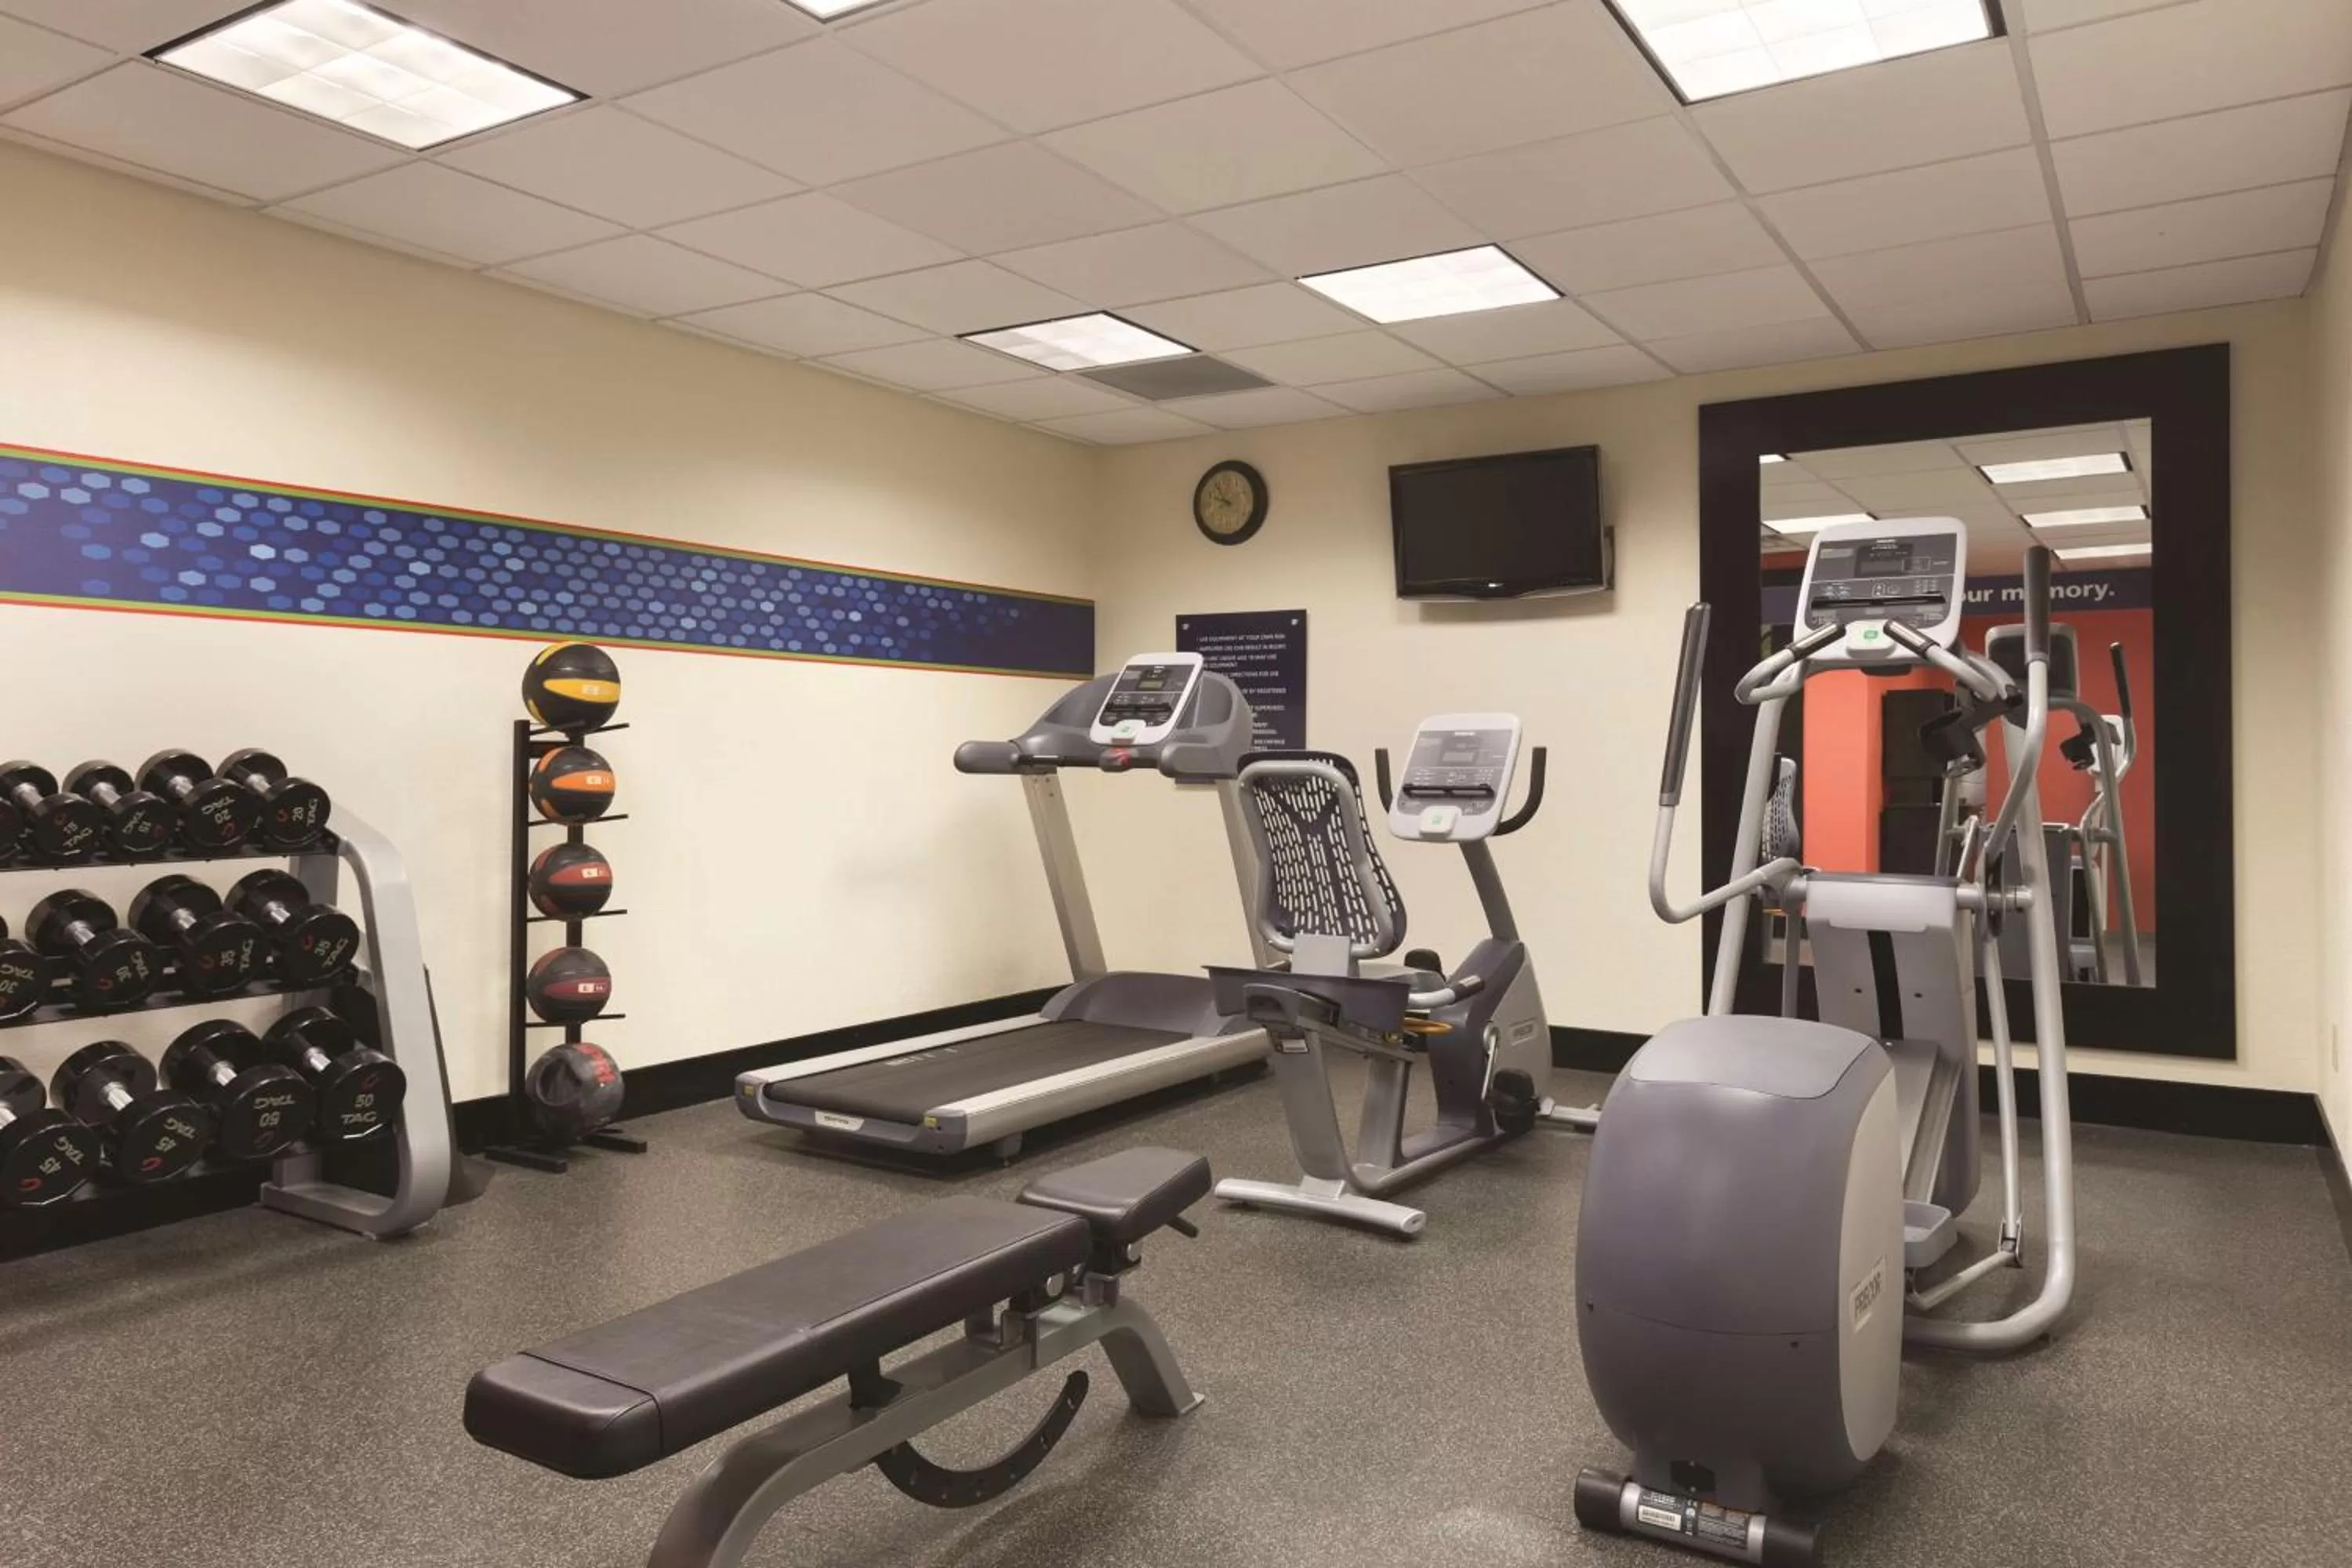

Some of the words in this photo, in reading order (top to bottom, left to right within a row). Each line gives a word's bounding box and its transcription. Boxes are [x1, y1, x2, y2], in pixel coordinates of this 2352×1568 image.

[2002, 583, 2115, 601] mmory.
[200, 795, 236, 815] TAG
[307, 798, 319, 826] TAG
[214, 808, 232, 824] 20
[292, 806, 304, 822] 20
[220, 949, 235, 967] 35
[240, 939, 254, 973] TAG
[0, 964, 34, 980] TAG
[252, 1094, 296, 1109] TAG
[355, 1094, 374, 1108] 50
[259, 1111, 281, 1127] 50
[339, 1111, 377, 1124] TAG
[162, 1116, 196, 1140] TAG
[53, 1136, 85, 1166] TAG
[154, 1136, 177, 1153] 45
[38, 1156, 62, 1175] 45
